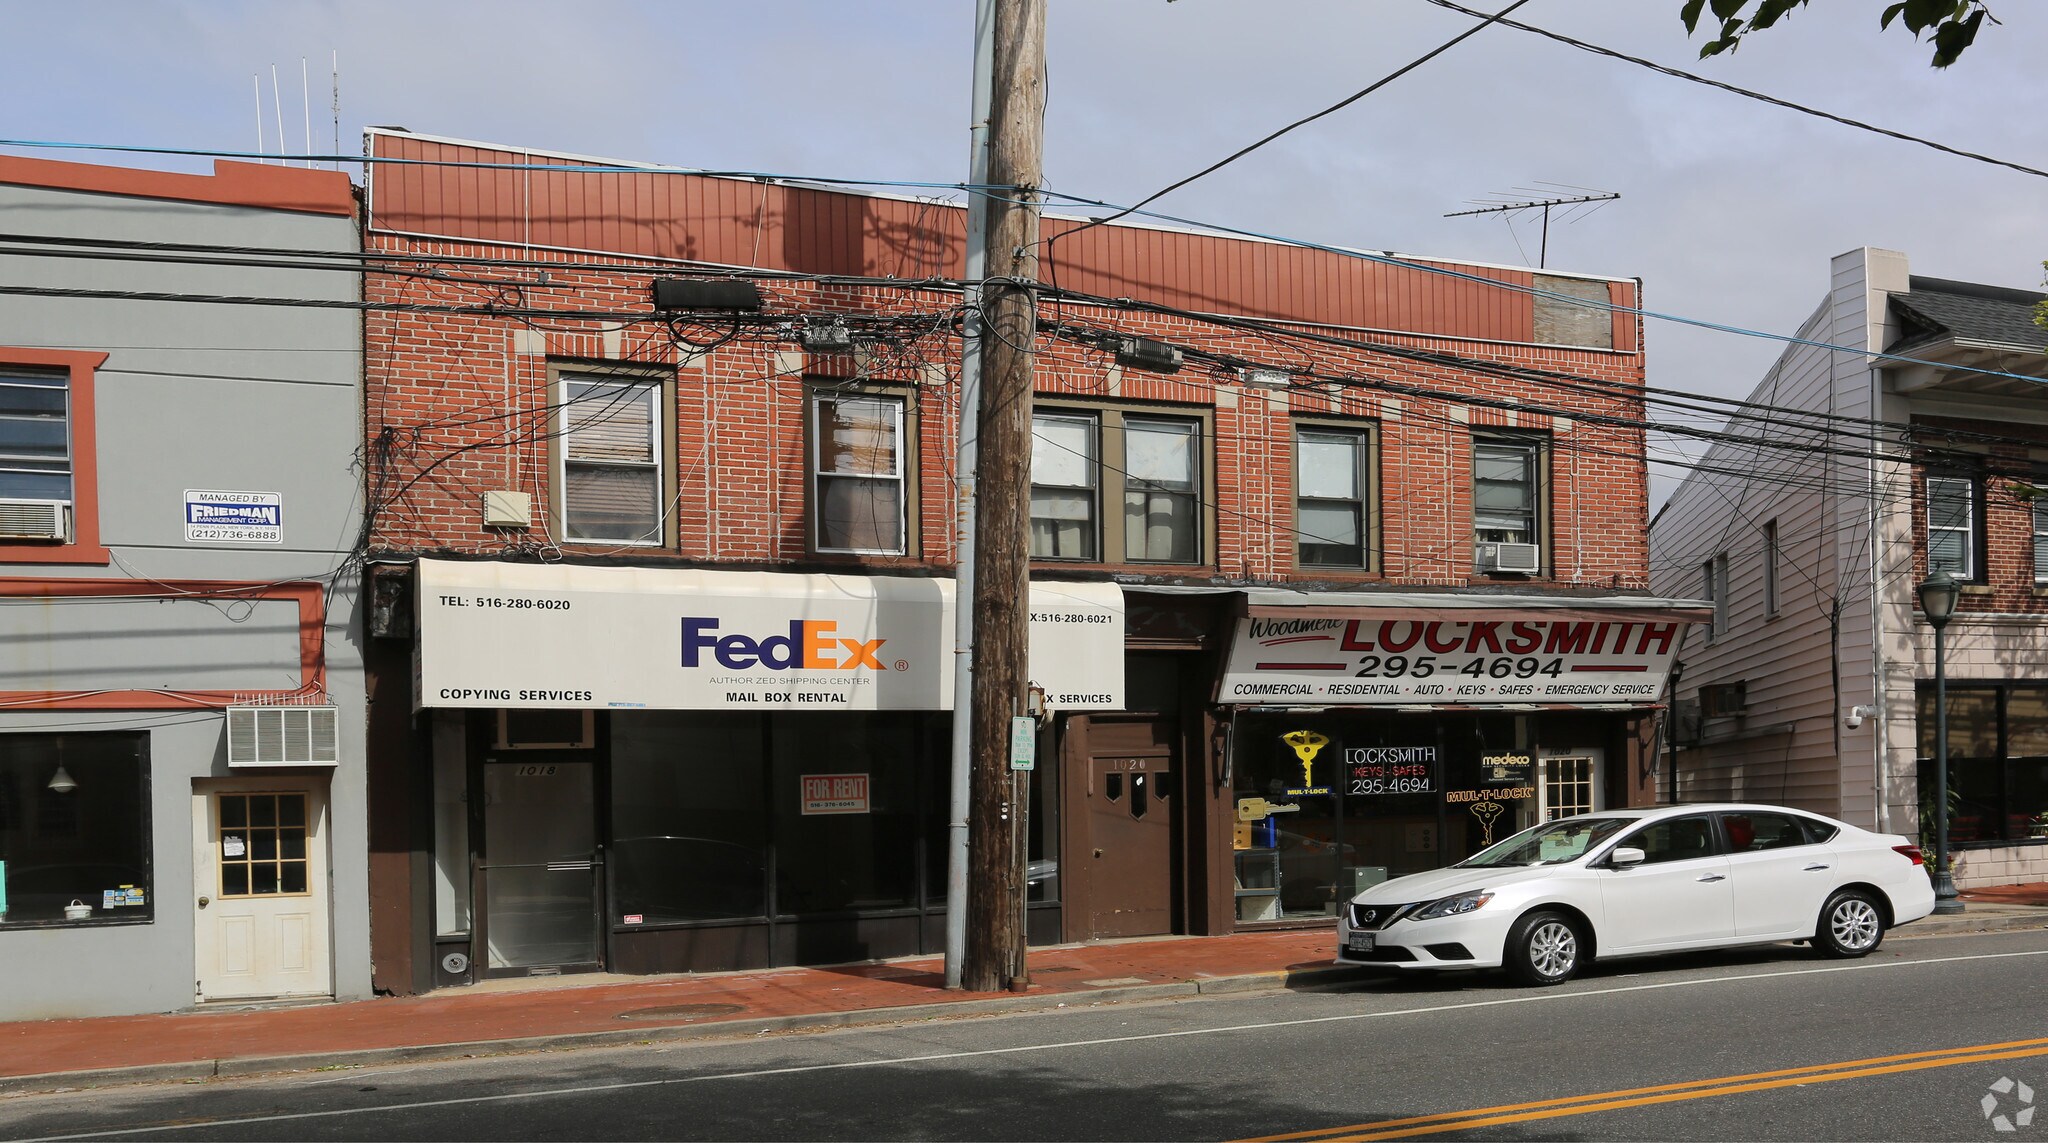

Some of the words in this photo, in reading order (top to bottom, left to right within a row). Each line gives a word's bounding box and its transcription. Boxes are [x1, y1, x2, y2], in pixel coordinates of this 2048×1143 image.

[199, 493, 250, 503] MANAGED
[252, 495, 266, 503] BY
[190, 504, 276, 525] FRIEDMAN
[439, 595, 470, 607] TEL:
[476, 597, 571, 610] 516-280-6020
[1030, 613, 1112, 623] X:516-280-6021
[681, 616, 888, 671] FedEx
[1340, 620, 1678, 654] LOCKSMITH
[1355, 655, 1564, 679] 295-4694
[778, 677, 827, 685] SHIPPING
[829, 677, 870, 685] CENTER
[440, 688, 511, 701] COPYING
[519, 689, 592, 701] SERVICES
[1234, 684, 1313, 695] COMMERCIAL
[1327, 684, 1401, 695] RESIDENTIAL
[1413, 684, 1444, 695] AUTO
[1457, 684, 1487, 695] KEYS
[1498, 684, 1534, 695] SAFES
[1544, 684, 1609, 695] EMERGENCY
[1612, 684, 1655, 695] SERVICE
[726, 692, 759, 703] MAIL
[764, 692, 792, 703] BOX
[797, 692, 847, 703] RENTAL
[1059, 694, 1112, 703] SERVICES
[1345, 747, 1436, 764] LOCKSMITH
[1482, 752, 1530, 765] medeco
[1114, 758, 1146, 770] 1020
[519, 766, 556, 776] 1018
[1355, 766, 1384, 777] KEYS
[1392, 765, 1426, 776] SAFES
[805, 779, 830, 799] FOR
[834, 778, 865, 799] RENT
[1352, 777, 1429, 794] 295-4694
